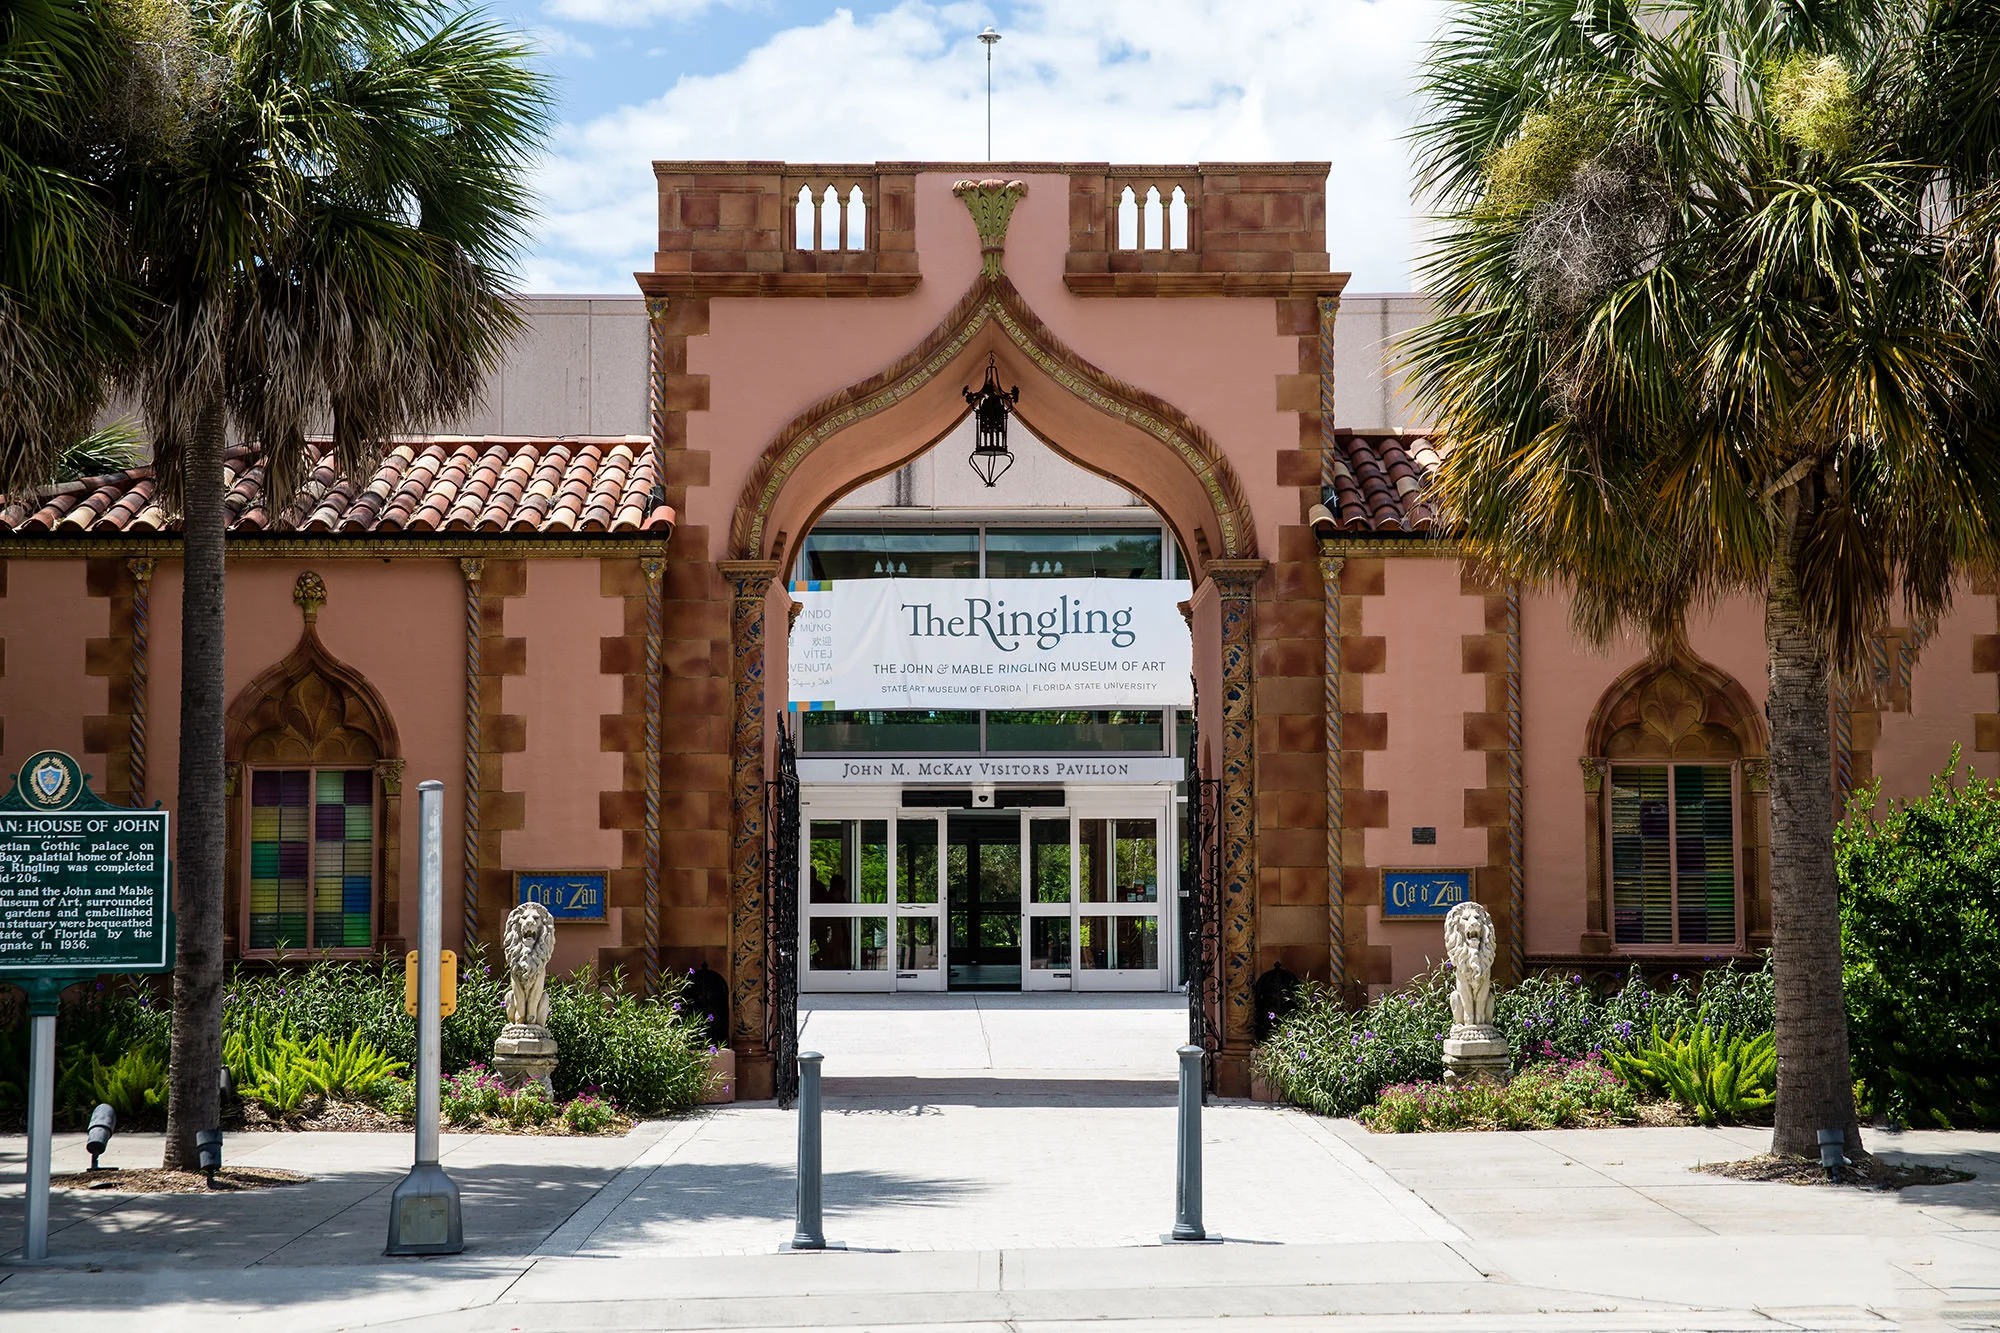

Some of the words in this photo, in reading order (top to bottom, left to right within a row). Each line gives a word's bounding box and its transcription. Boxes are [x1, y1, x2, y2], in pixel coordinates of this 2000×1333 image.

[803, 648, 832, 659] VÍTEJ
[873, 663, 897, 674] THE
[900, 663, 933, 674] JOHN
[936, 663, 949, 675] &
[952, 664, 994, 675] MABLE
[998, 661, 1057, 674] RINGLING
[1060, 660, 1117, 672] MUSEUM
[1121, 661, 1138, 671] OF
[1141, 661, 1166, 671] ART
[881, 684, 907, 693] STATE
[909, 684, 925, 693] ART
[927, 686, 967, 694] MUSEUM
[969, 685, 981, 693] OF
[983, 684, 1021, 693] FLORIDA
[1032, 683, 1071, 692] FLORIDA
[1074, 682, 1101, 690] STATE
[1104, 682, 1157, 690] UNIVERSITY
[842, 763, 882, 778] JOHN
[890, 763, 910, 775] M.
[979, 763, 1050, 775] VISITORS
[1056, 763, 1128, 775] PAVILION
[27, 819, 82, 832] HOUSE
[87, 819, 108, 832] OF
[113, 819, 160, 832] JOHN
[0, 842, 31, 851] etian
[41, 841, 80, 851] Gothic
[91, 841, 129, 853] palace
[139, 842, 154, 850] on
[29, 852, 73, 863] palatial
[76, 852, 107, 861] home
[109, 852, 122, 861] of
[125, 851, 154, 861] John
[11, 863, 60, 874] Ringling
[67, 864, 88, 872] was
[95, 862, 154, 874] completed
[17, 887, 39, 896] and
[41, 887, 61, 896] the
[62, 886, 91, 896] John
[95, 886, 116, 896] and
[119, 886, 154, 896] Mable
[563, 883, 597, 910] Zan
[1429, 880, 1463, 907] Zan
[42, 897, 56, 907] of
[58, 897, 83, 907] Art,
[86, 896, 153, 907] surrounded
[5, 908, 51, 920] gardens
[57, 908, 79, 917] and
[85, 907, 153, 917] embellished
[7, 920, 57, 930] statuary
[59, 920, 86, 928] were
[87, 918, 153, 930] bequeathed
[31, 929, 45, 939] of
[54, 929, 96, 939] Florida
[107, 929, 123, 940] by
[133, 929, 153, 938] the
[0, 941, 34, 953] gnate
[41, 941, 52, 950] in
[60, 940, 90, 950] 1936.
